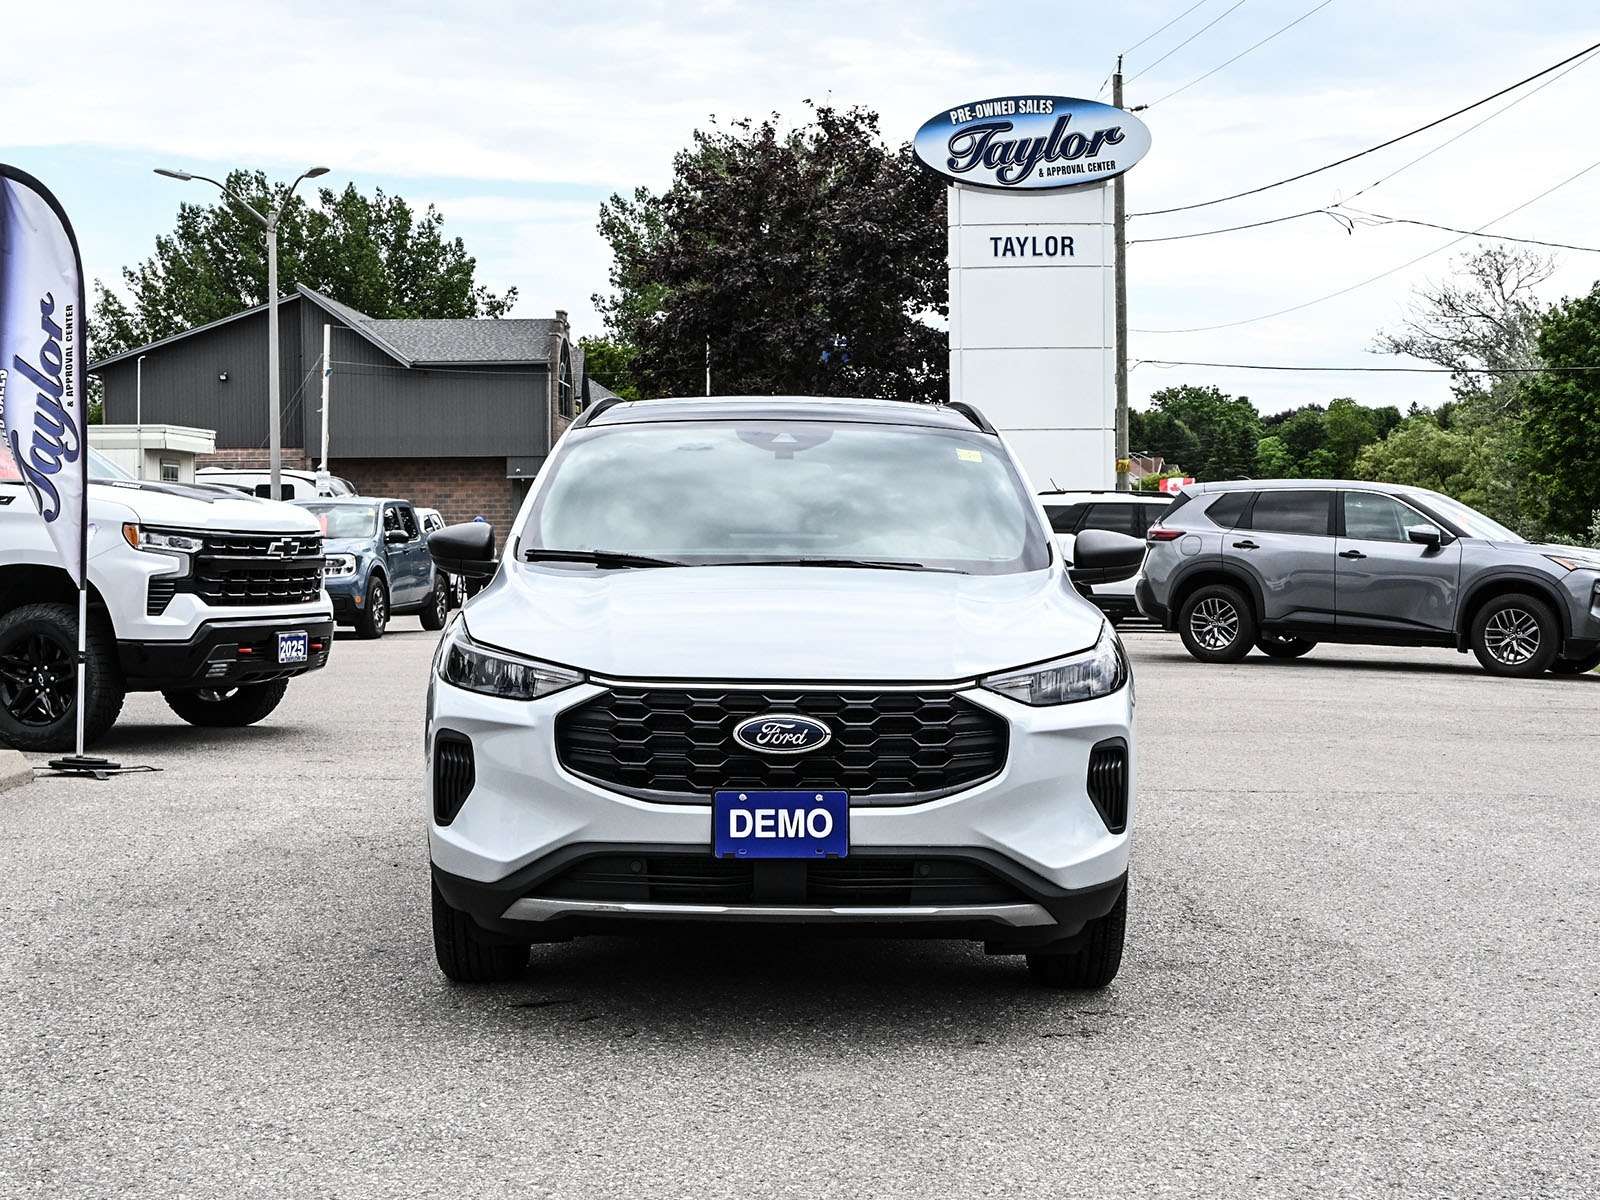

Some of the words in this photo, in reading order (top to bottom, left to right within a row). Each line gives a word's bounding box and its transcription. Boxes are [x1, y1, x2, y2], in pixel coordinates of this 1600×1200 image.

[949, 100, 1016, 125] PRE-OWNED
[1018, 99, 1054, 115] SALES
[946, 112, 1126, 186] Taylor
[1038, 168, 1045, 178] &
[1046, 163, 1086, 178] APPROVAL
[1087, 160, 1117, 173] CENTER
[989, 235, 1075, 257] TAYLOR
[64, 304, 74, 342] CENTER
[64, 345, 74, 398] APPROVAL
[10, 292, 80, 523] Taylor
[66, 400, 74, 408] &
[280, 640, 305, 658] 2025
[756, 722, 809, 745] Ford
[729, 808, 834, 838] DEMO
